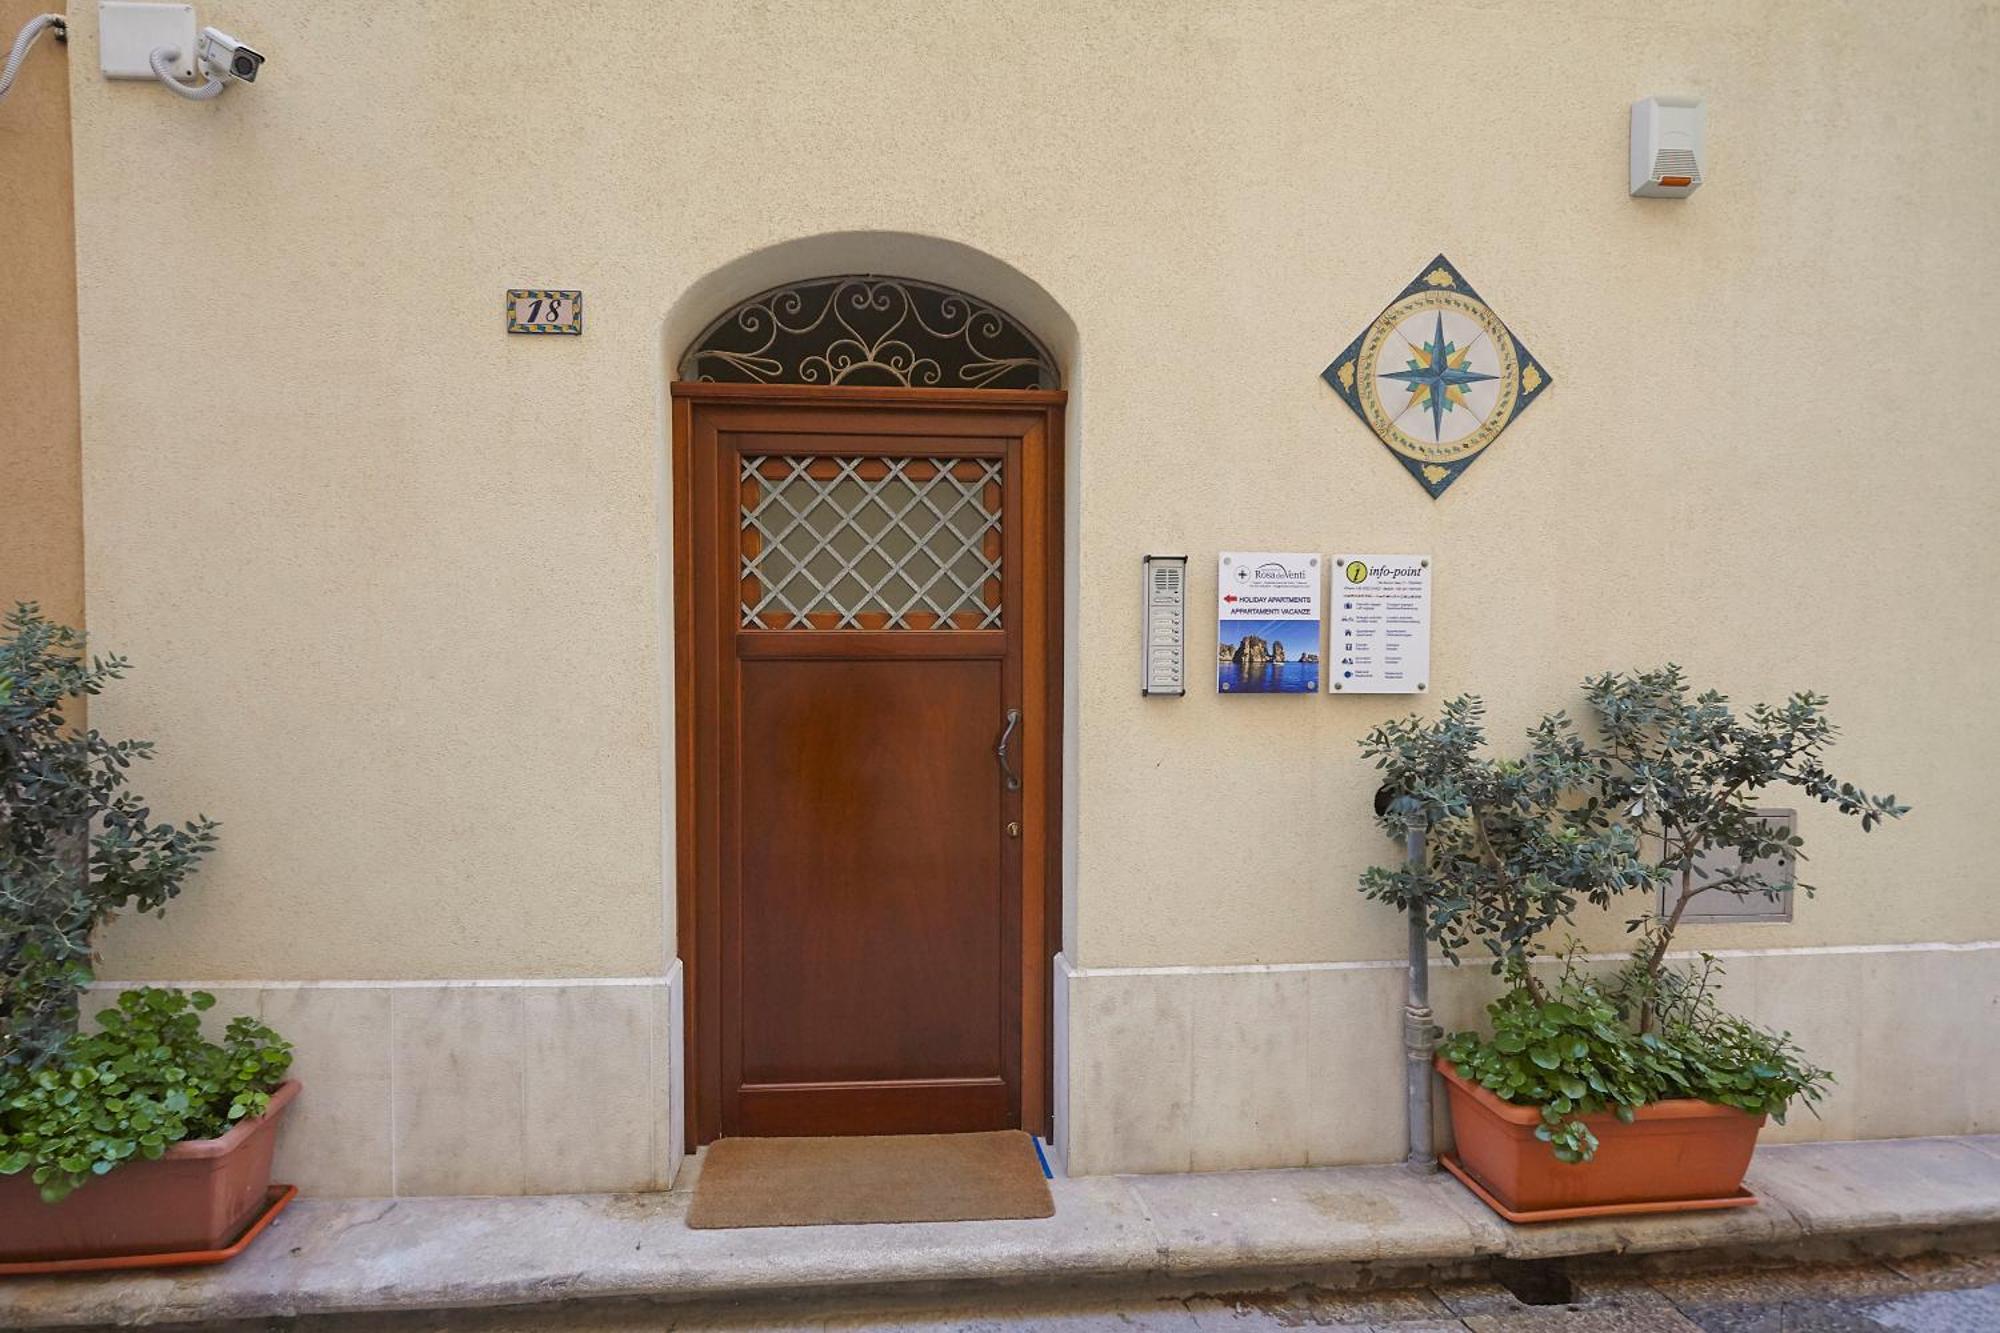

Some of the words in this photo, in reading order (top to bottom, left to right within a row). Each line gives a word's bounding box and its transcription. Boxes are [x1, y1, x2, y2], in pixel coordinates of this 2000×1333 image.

[527, 299, 562, 323] 18
[1255, 569, 1276, 580] Rosa
[1368, 565, 1423, 579] info-point
[1239, 596, 1267, 604] HOLIDAY
[1267, 596, 1312, 604] APARTMENTS
[1230, 608, 1280, 616] APPARTAMENTI
[1280, 608, 1311, 616] VACANZE
